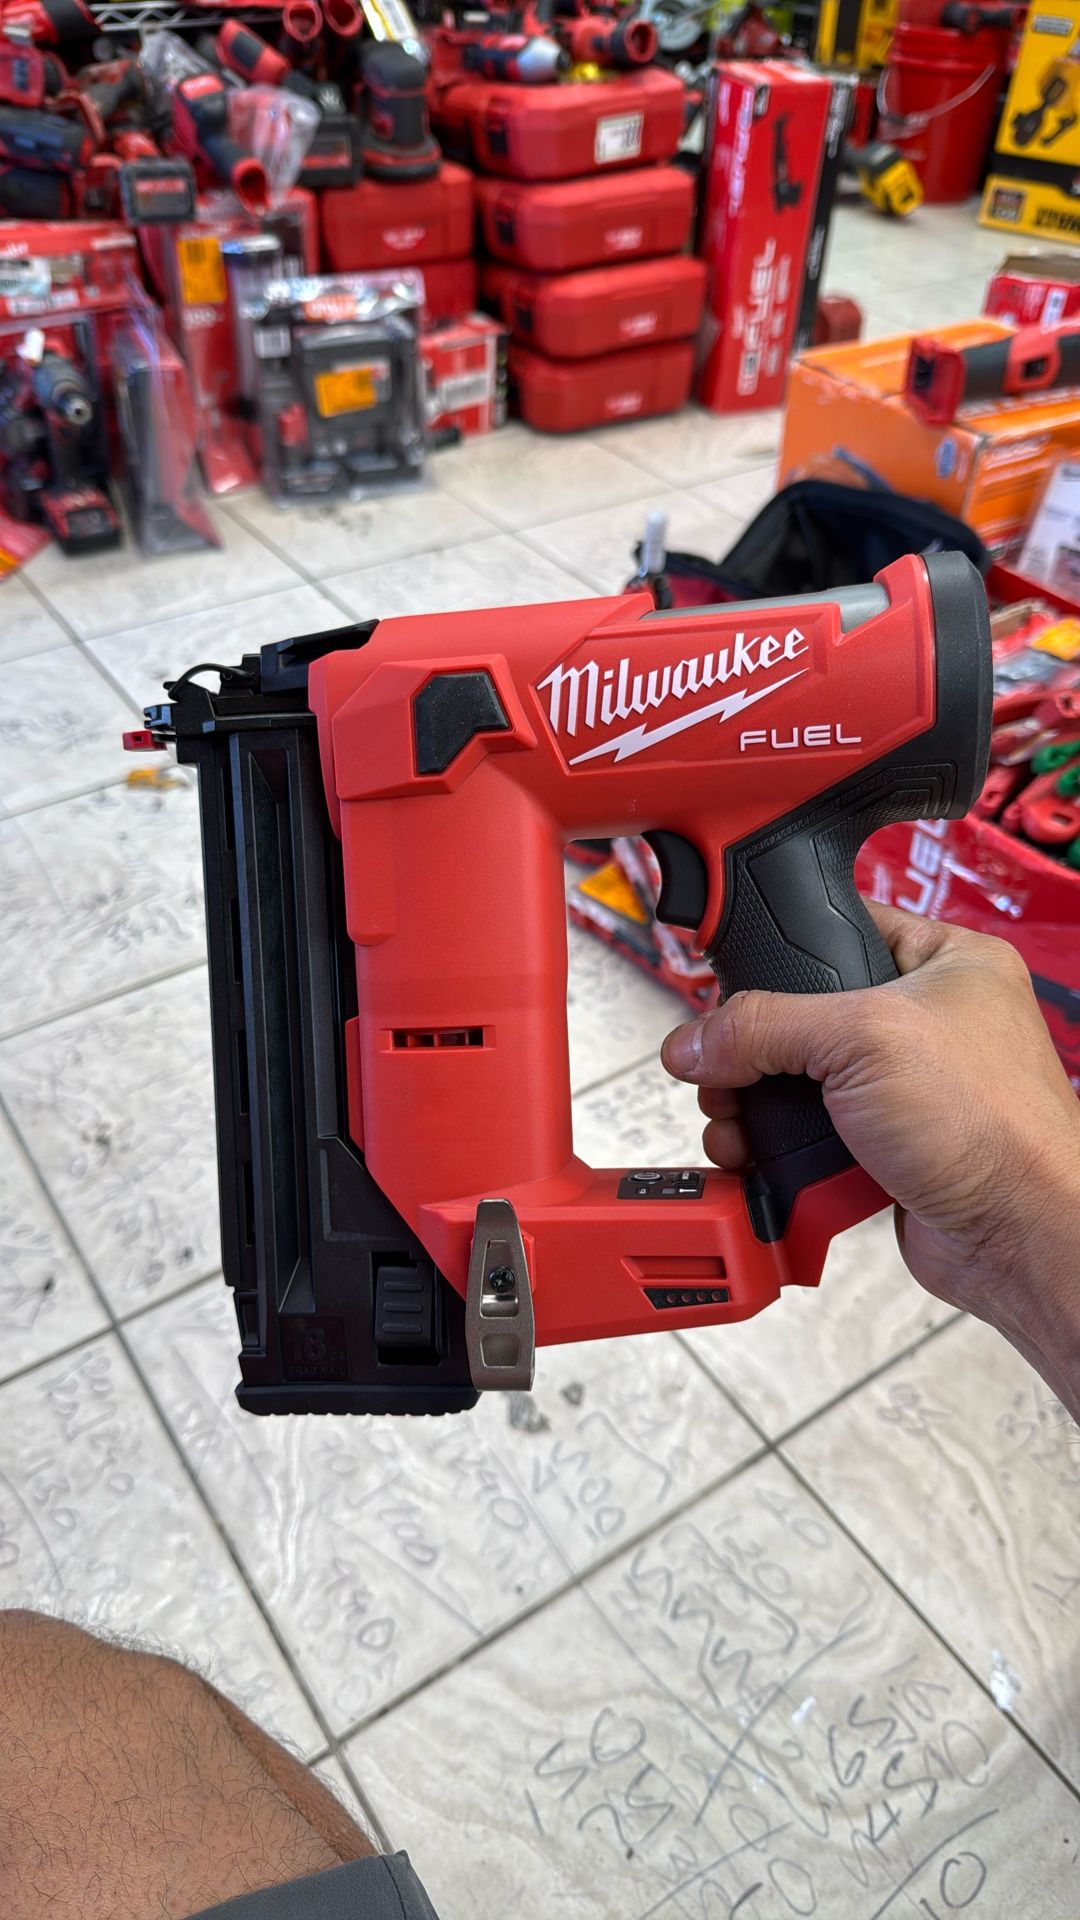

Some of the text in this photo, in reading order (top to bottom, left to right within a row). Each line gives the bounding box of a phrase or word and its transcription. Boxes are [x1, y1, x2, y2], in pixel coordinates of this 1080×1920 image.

[537, 627, 810, 737] Milwaukee
[739, 723, 862, 752] FUEL
[896, 818, 946, 915] UEL
